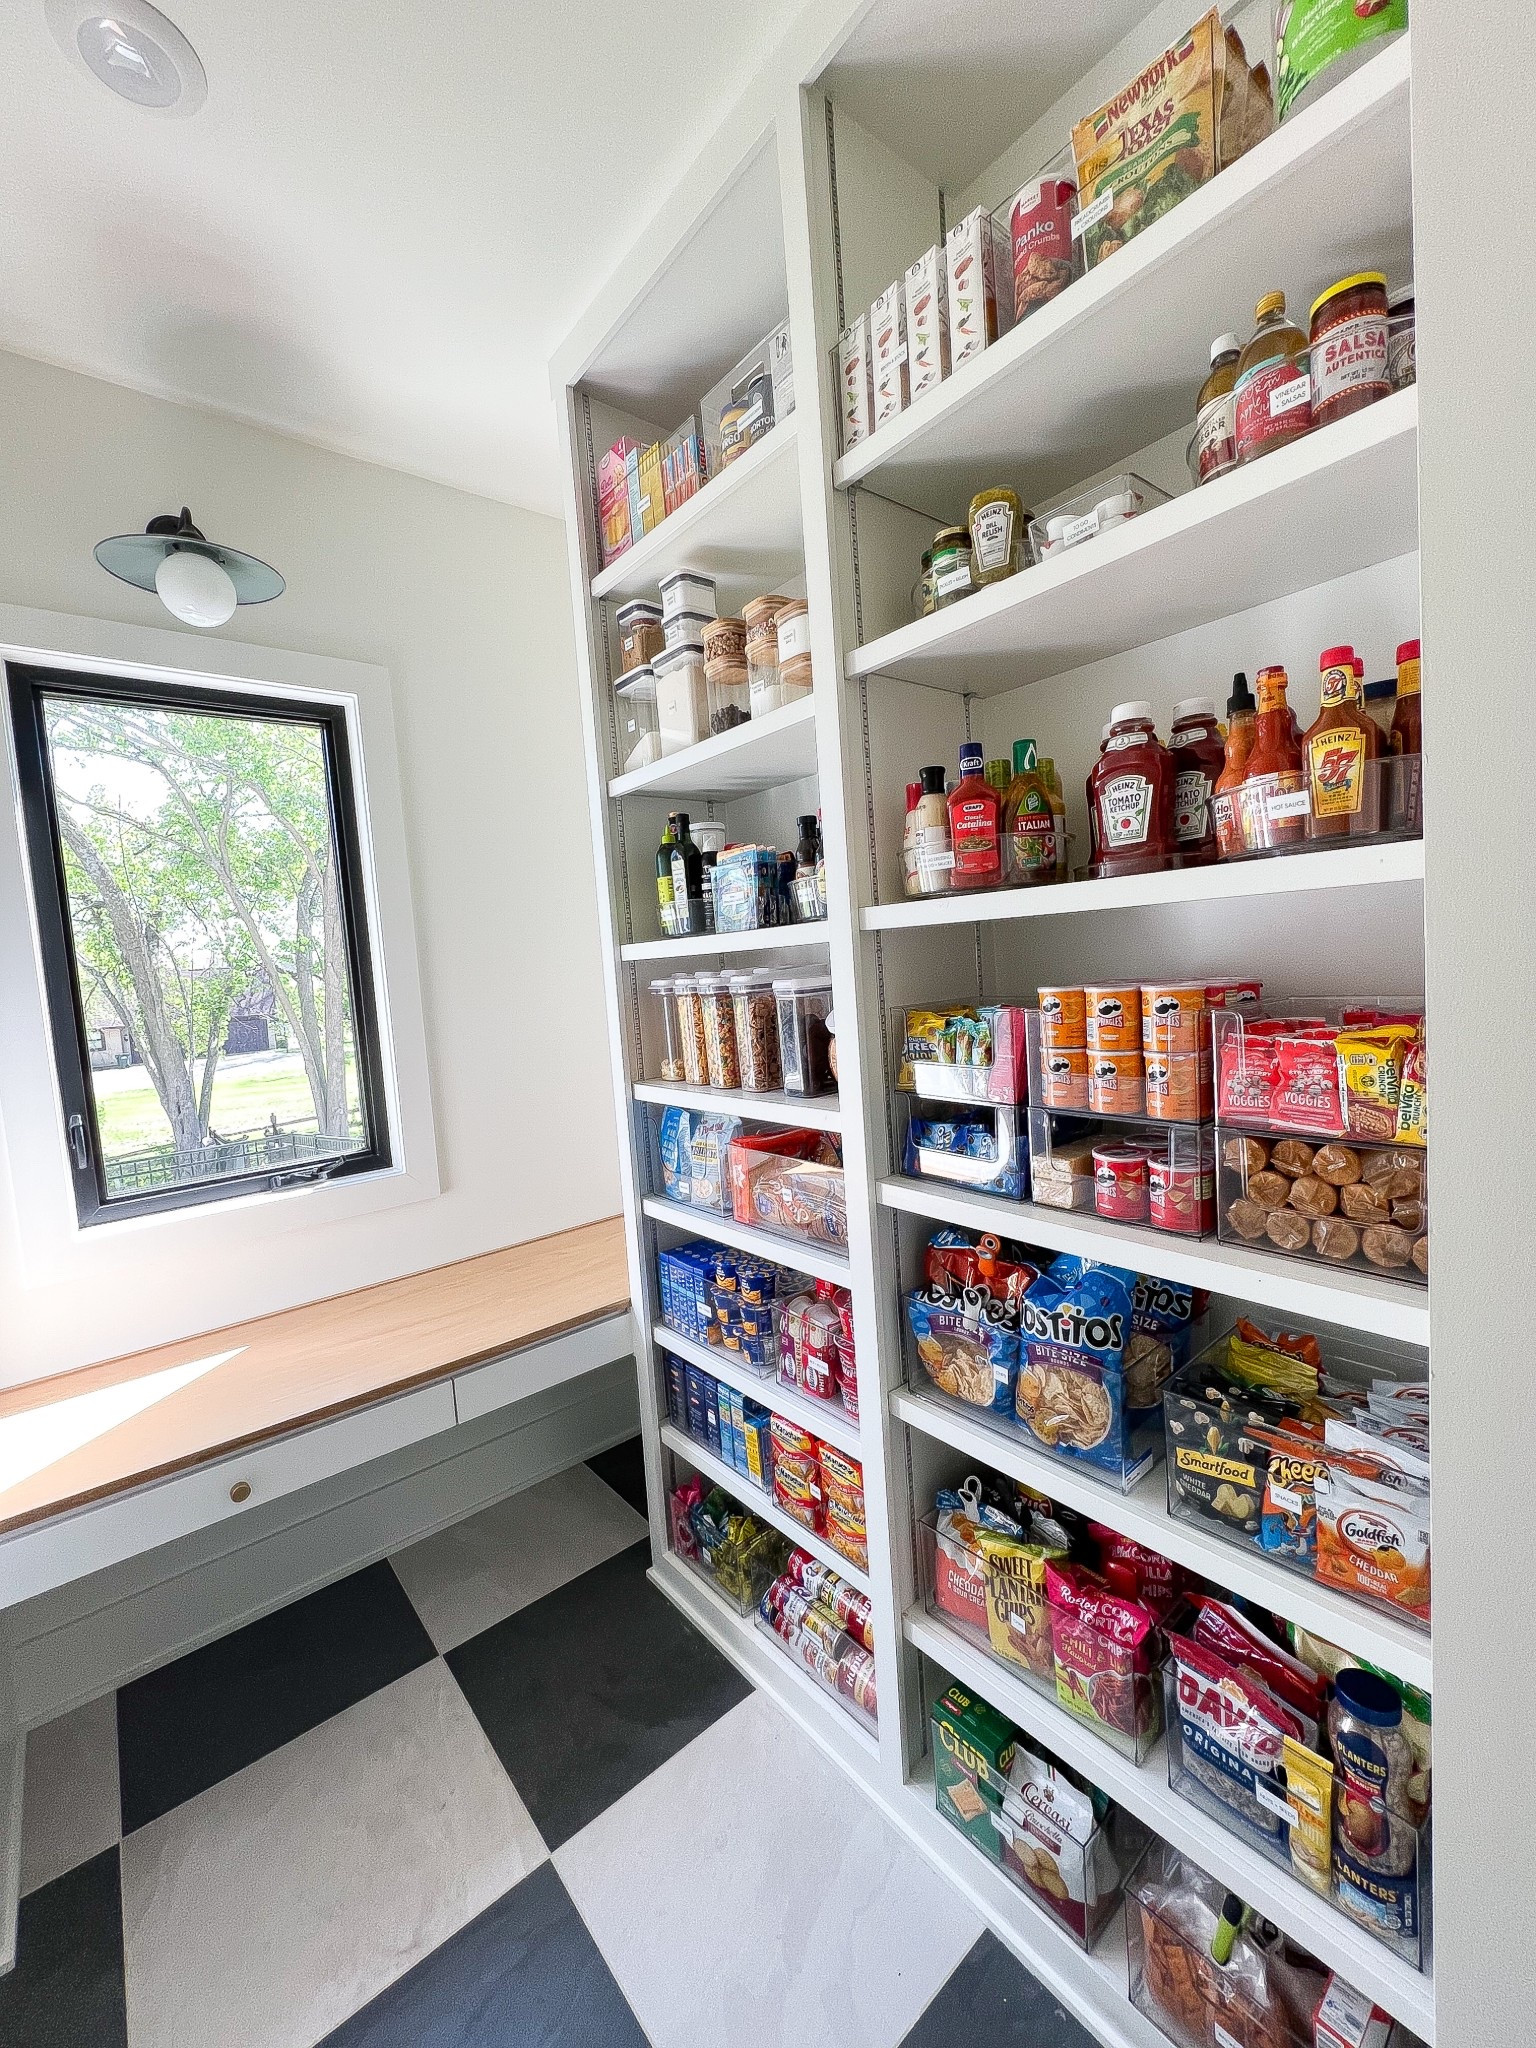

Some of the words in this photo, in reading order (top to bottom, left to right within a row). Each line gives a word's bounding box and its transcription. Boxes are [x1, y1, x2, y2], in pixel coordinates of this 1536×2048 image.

[1015, 221, 1055, 254] Panko
[1028, 233, 1060, 249] Crumbs
[1325, 331, 1386, 362] SALSA
[1275, 381, 1306, 399] VINEGAR
[1281, 391, 1306, 407] SALSAS
[981, 508, 1002, 520] HEINZ
[982, 527, 1003, 538] RELISH
[986, 521, 997, 530] DILL
[1321, 733, 1351, 746] HEINZ
[963, 759, 980, 768] Kraft
[1318, 747, 1359, 782] 57
[1112, 782, 1135, 792] HEINZ
[1176, 789, 1200, 799] MATO
[1108, 793, 1141, 807] TOMATO
[1110, 802, 1140, 813] KETCHUP
[1176, 798, 1199, 807] TCHUP
[1285, 799, 1306, 809] SAUCE
[956, 820, 993, 830] Catalina
[1018, 820, 1050, 832] ITALIAN
[1098, 1015, 1123, 1027] PRINGLES
[1155, 1015, 1180, 1027] PRINGLES
[1094, 1078, 1117, 1090] PRINGLES
[1378, 1066, 1386, 1097] CRUNCHY
[1386, 1058, 1400, 1104] belVita
[1228, 1094, 1271, 1108] YOGGIES
[1284, 1091, 1332, 1109] YOGGIES
[1401, 1084, 1414, 1130] belVita
[939, 1315, 963, 1326] BITE
[1022, 1303, 1123, 1350] OSTITOS
[1133, 1315, 1158, 1331] SIZE
[1035, 1345, 1056, 1359] BITE
[1061, 1349, 1089, 1366] SIZE
[817, 1369, 825, 1393] WHIT
[775, 1422, 801, 1442] Maruchan
[1181, 1453, 1249, 1480] Smartfood
[780, 1467, 805, 1489] Maruchan
[1182, 1472, 1206, 1489] WHITE
[1274, 1492, 1299, 1507] SNACKS
[1345, 1522, 1401, 1547] Goldfish
[1131, 1549, 1172, 1566] CORN
[989, 1553, 1033, 1581] SWEET
[1145, 1566, 1172, 1581] ILLA
[1349, 1554, 1398, 1583] CHEDDAR
[948, 1570, 984, 1600] CHEDDA
[1142, 1584, 1173, 1598] HIPS
[953, 1584, 968, 1600] SOUR
[969, 1593, 985, 1608] CREA
[994, 1599, 1035, 1627] CHIPS
[1101, 1603, 1139, 1632] CORN
[1061, 1633, 1092, 1659] CHILI
[1062, 1643, 1097, 1671] Flavored
[948, 1688, 970, 1707] CLUB
[939, 1720, 990, 1780] CLUB
[1000, 1742, 1015, 1768] CLU
[1338, 1740, 1387, 1777] PLANTERS
[1347, 1774, 1380, 1794] PEANUTS
[1021, 1782, 1074, 1832] Cervasi
[1259, 1792, 1275, 1804] NUTS
[1279, 1804, 1296, 1821] SEEDS
